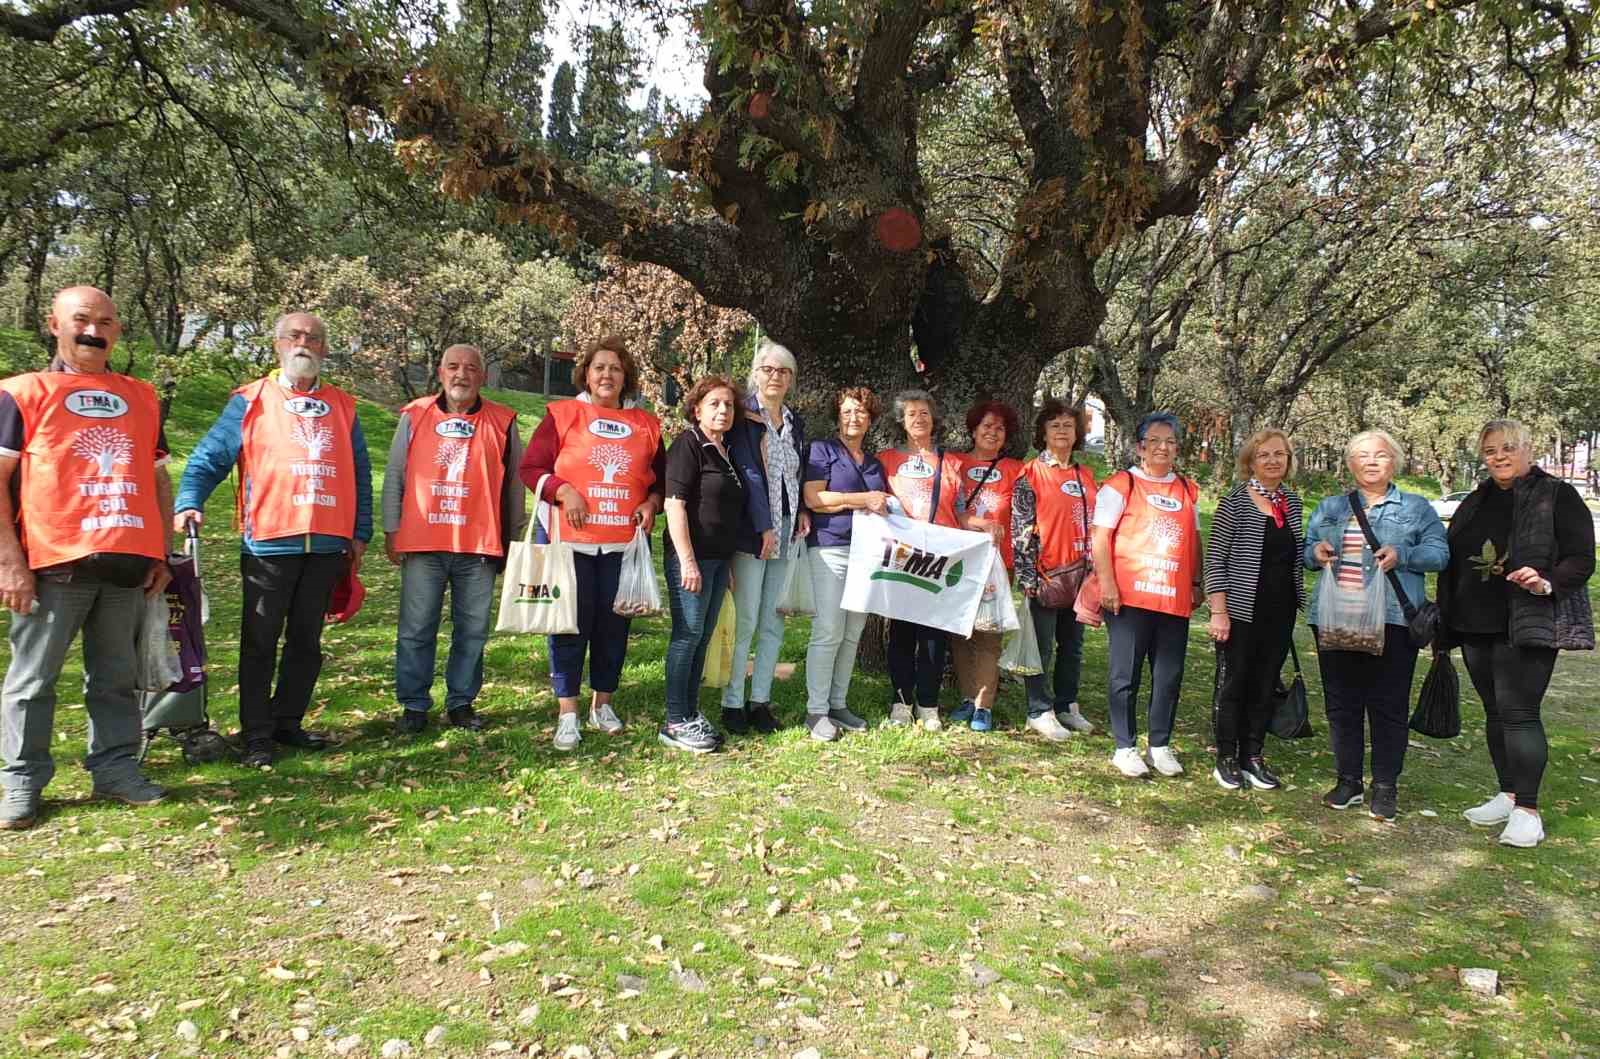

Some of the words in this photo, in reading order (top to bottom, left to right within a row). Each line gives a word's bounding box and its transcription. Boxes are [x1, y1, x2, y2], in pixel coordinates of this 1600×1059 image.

[78, 394, 112, 408] TEMA
[598, 421, 620, 433] TEMA
[587, 484, 630, 500] TÜRKİYE
[598, 499, 619, 514] ÇÖL
[881, 537, 949, 580] TEMA
[518, 583, 550, 599] TEMA
